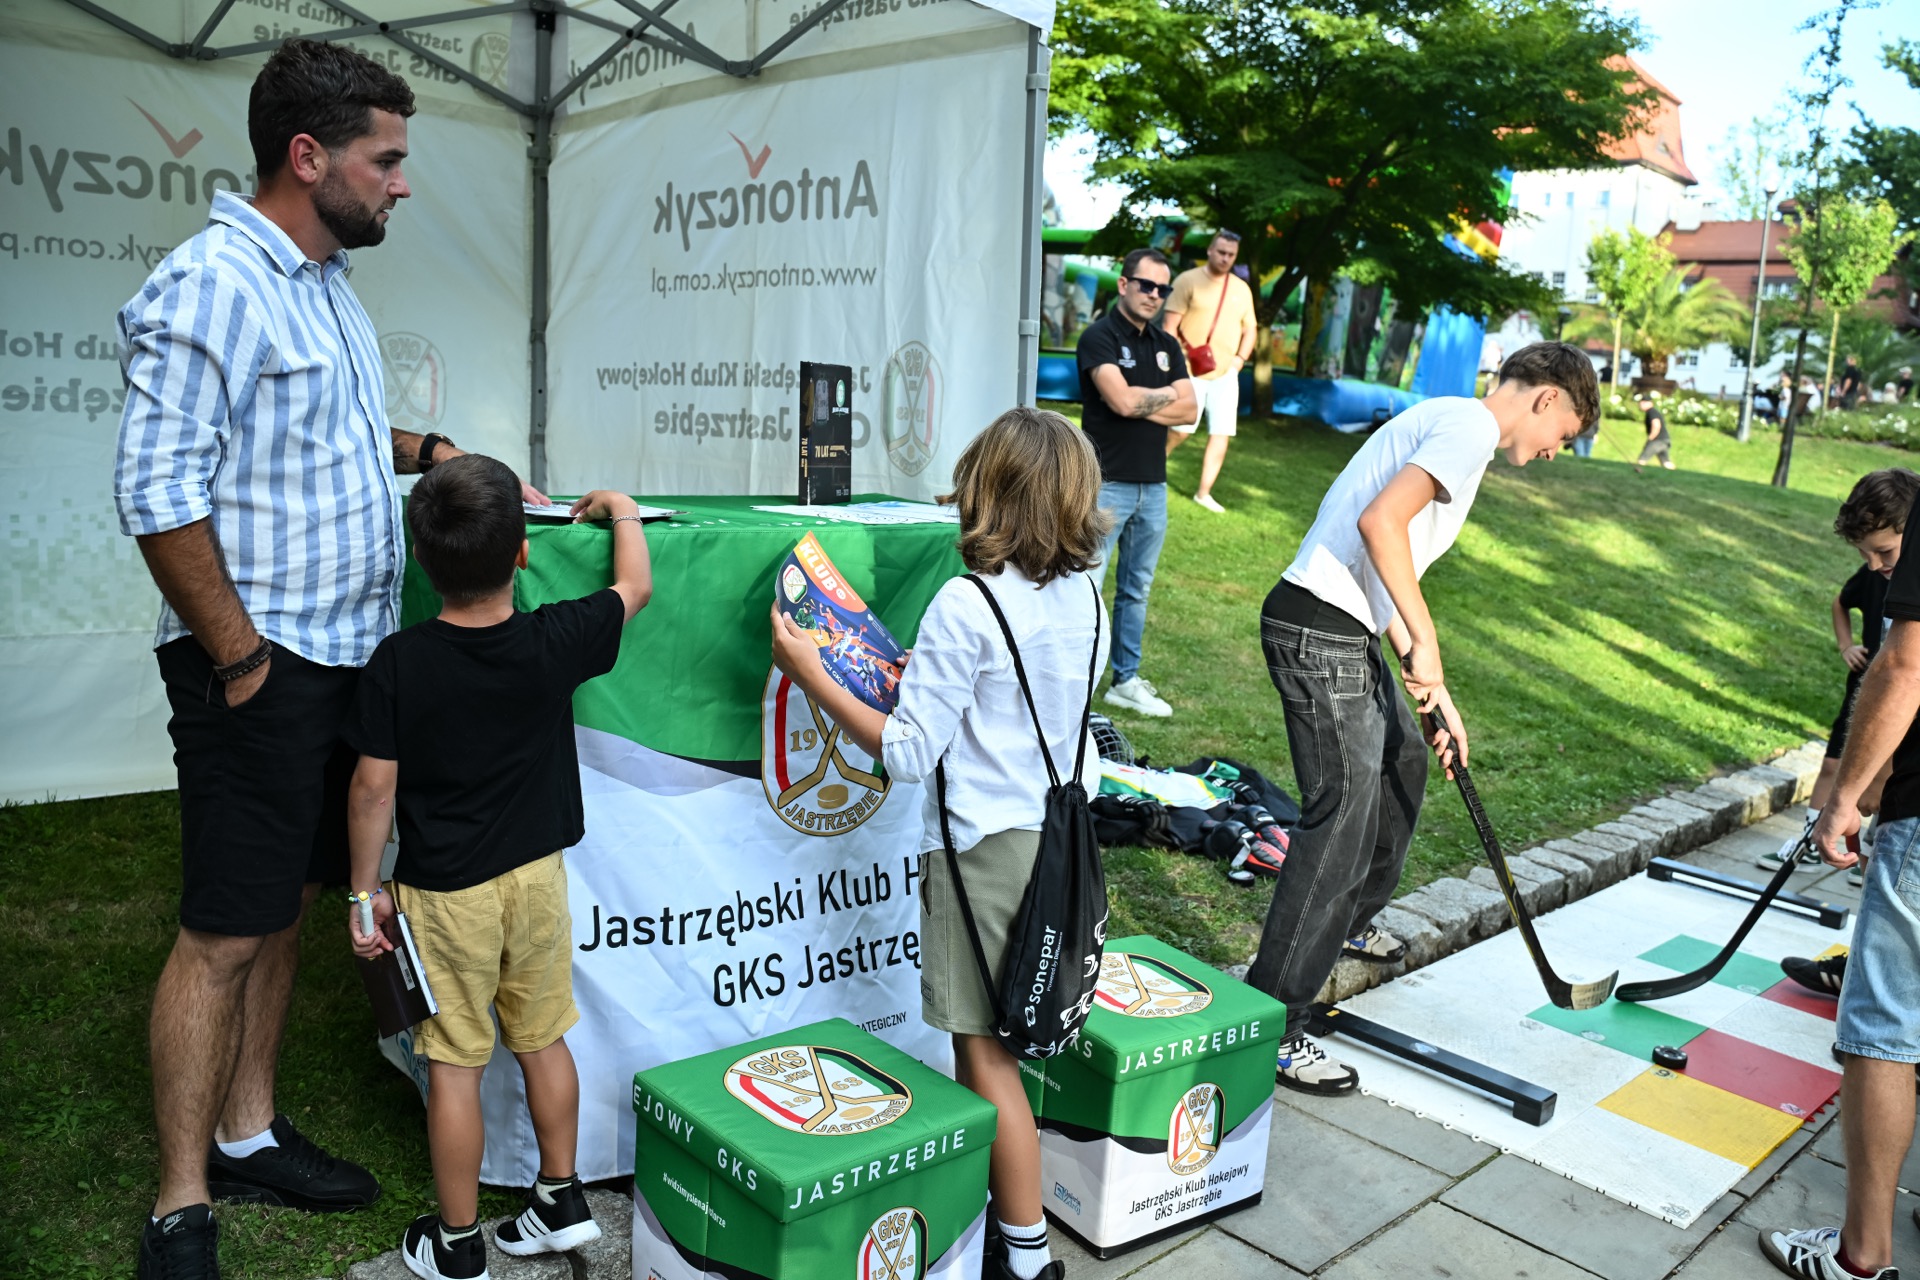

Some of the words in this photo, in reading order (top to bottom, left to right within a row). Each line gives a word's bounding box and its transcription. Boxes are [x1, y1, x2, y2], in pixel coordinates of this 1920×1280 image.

[799, 541, 838, 592] KLUB
[790, 728, 818, 753] 19
[785, 789, 879, 831] JASTRZĘBIE
[578, 876, 805, 952] Jastrzębski
[817, 862, 891, 914] Klub
[713, 953, 786, 1007] GKS
[797, 930, 922, 989] Jastrzę
[1029, 925, 1057, 1005] sonepar
[856, 1011, 907, 1033] ATEGICZNY
[748, 1050, 806, 1075] GKS
[1070, 1034, 1093, 1059] KS
[1120, 1020, 1261, 1075] JASTRZĘBIE
[780, 1096, 812, 1109] 19
[831, 1077, 863, 1091] 63
[1188, 1087, 1211, 1109] GKS
[815, 1100, 907, 1134] JASTRZĘBIE
[632, 1084, 694, 1143] EJOWY
[717, 1147, 759, 1192] GKS
[789, 1128, 966, 1210] JASTRZĘBIE
[1129, 1184, 1183, 1215] Jastrzębski
[1185, 1177, 1206, 1195] Klub
[1208, 1163, 1249, 1188] Hokejowy
[1155, 1202, 1173, 1221] GKS
[1175, 1188, 1222, 1214] Jastrzębie
[878, 1212, 907, 1241] GKS
[899, 1255, 914, 1270] 63
